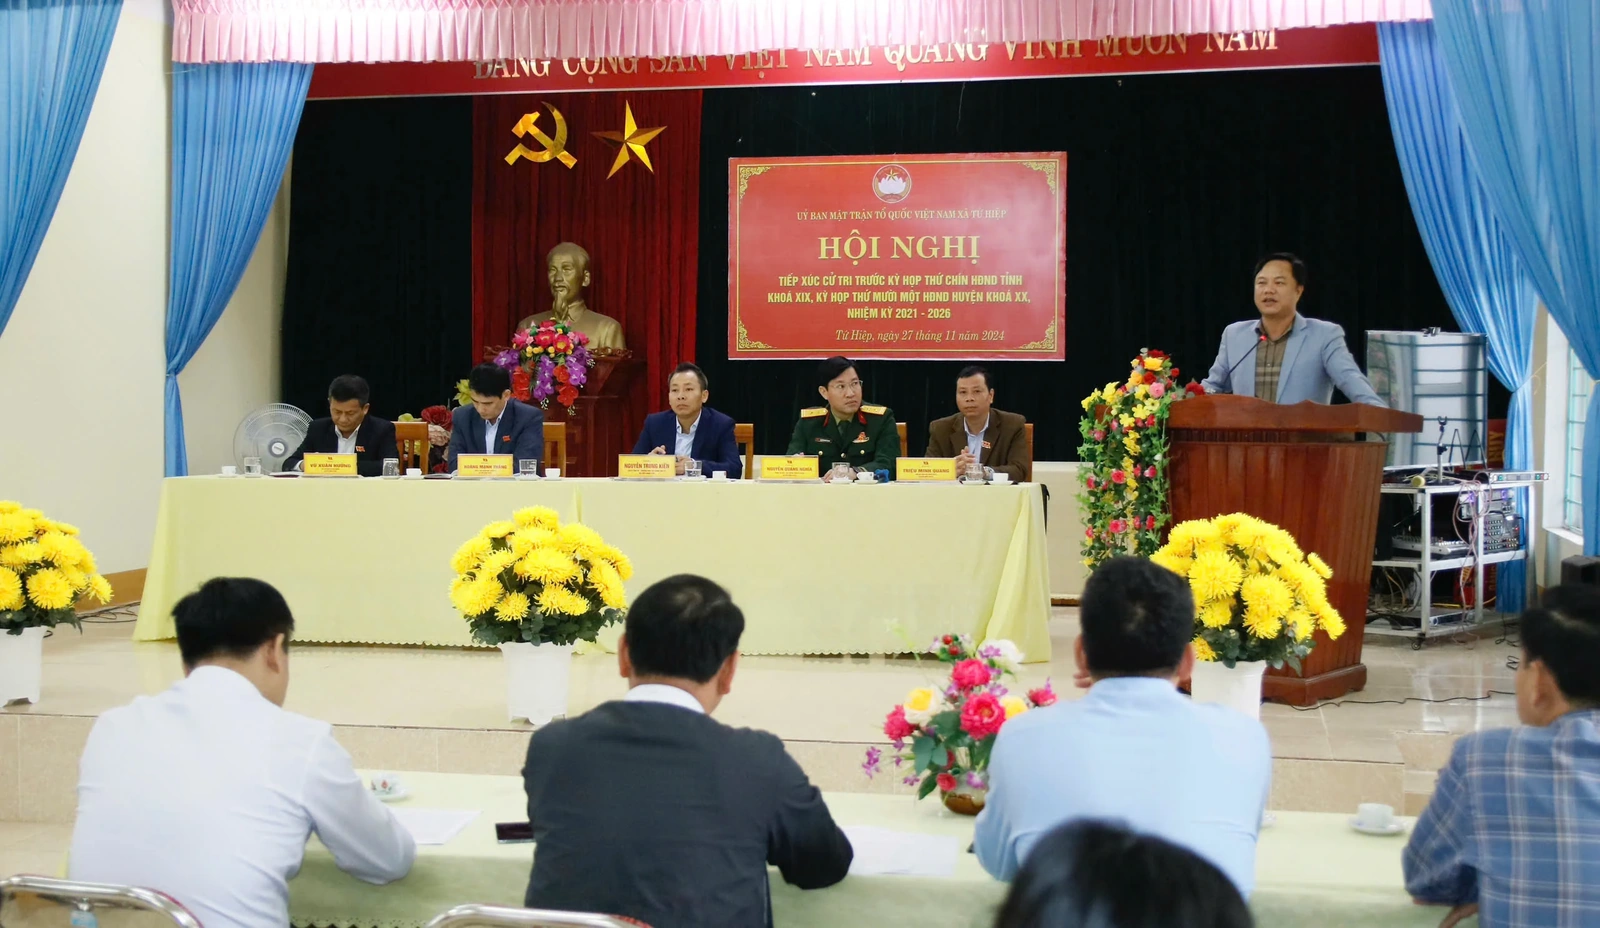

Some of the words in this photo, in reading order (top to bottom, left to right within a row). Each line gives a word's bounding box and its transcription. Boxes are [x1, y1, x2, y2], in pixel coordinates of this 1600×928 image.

[810, 211, 828, 220] BAN
[829, 209, 848, 222] MẶT
[849, 208, 873, 222] TRẬN
[875, 207, 886, 220] TỔ
[888, 207, 912, 221] QUỐC
[914, 208, 935, 221] VIỆT
[936, 210, 956, 219] NAM
[985, 207, 1007, 220] HIỆP
[818, 229, 881, 266] HỘI
[890, 235, 981, 265] NGHỊ
[778, 272, 799, 287] TIẾP
[801, 273, 820, 286] XÚC
[822, 271, 836, 286] CỬ
[838, 275, 852, 286] TRI
[855, 272, 885, 286] TRƯỚC
[888, 273, 900, 286] KỲ
[902, 275, 922, 288] HỌP
[924, 272, 944, 286] THỨ
[945, 272, 968, 286] CHÍN
[971, 275, 998, 286] HĐND
[1000, 271, 1023, 286] TỈNH
[767, 291, 793, 303] KHOÁ
[795, 292, 814, 304] XIX,
[816, 291, 828, 303] KỲ
[831, 292, 850, 305] HỌP
[852, 289, 871, 303] THỨ
[872, 289, 897, 303] MƯỜI
[899, 289, 920, 305] MỘT
[923, 291, 949, 303] HĐND
[952, 289, 984, 305] HUYỆN
[986, 289, 1012, 303] KHOÁ
[1014, 291, 1031, 304] XX,
[847, 306, 878, 321] NHIỆM
[880, 306, 893, 319] KỲ
[895, 308, 918, 319] 2021
[927, 308, 951, 319] 2026
[850, 329, 875, 343] Hiệp,
[877, 330, 900, 343] ngày
[902, 330, 914, 341] 27
[915, 329, 942, 343] tháng
[945, 330, 956, 341] 11
[958, 330, 979, 341] năm
[981, 330, 1005, 341] 2024
